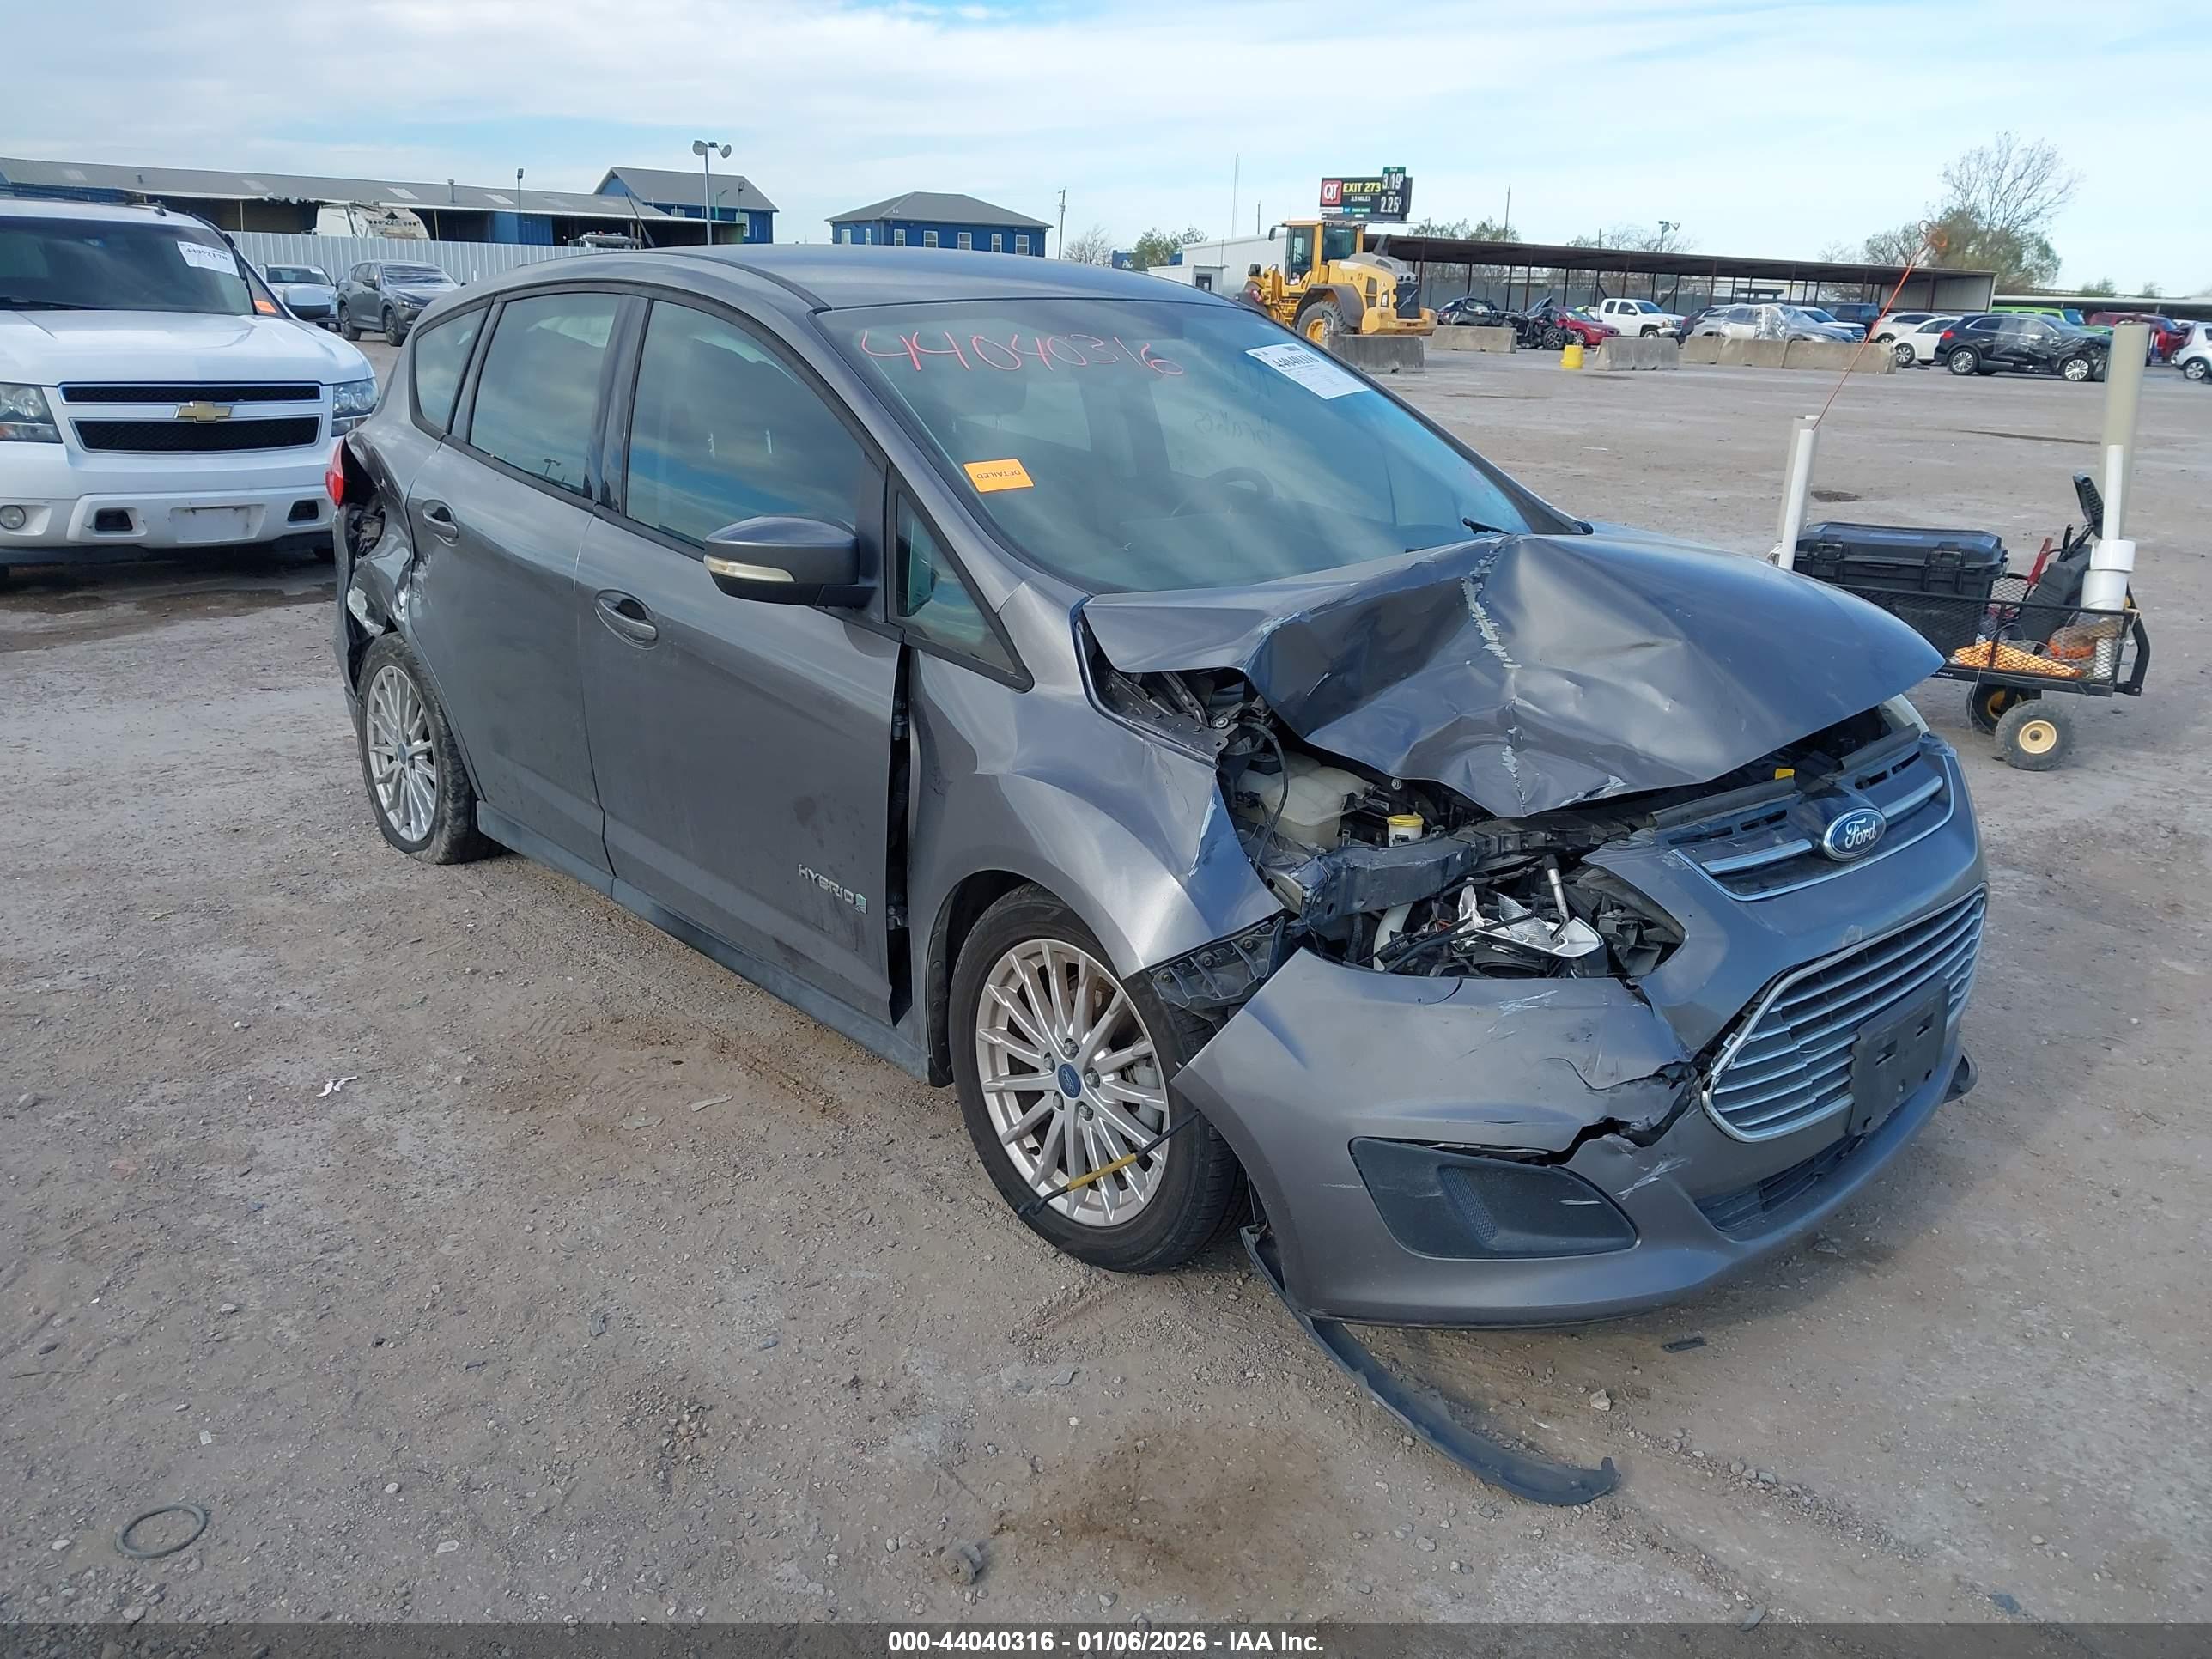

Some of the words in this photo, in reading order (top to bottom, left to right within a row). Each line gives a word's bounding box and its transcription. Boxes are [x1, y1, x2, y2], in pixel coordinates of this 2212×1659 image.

[1324, 184, 1339, 201] QT
[1343, 183, 1364, 193] EXIT
[1364, 182, 1381, 193] 273
[860, 330, 1184, 375] 44040316
[976, 469, 1021, 480] DETAILED
[1844, 817, 1877, 848] Ford
[798, 863, 854, 904] HYBRID
